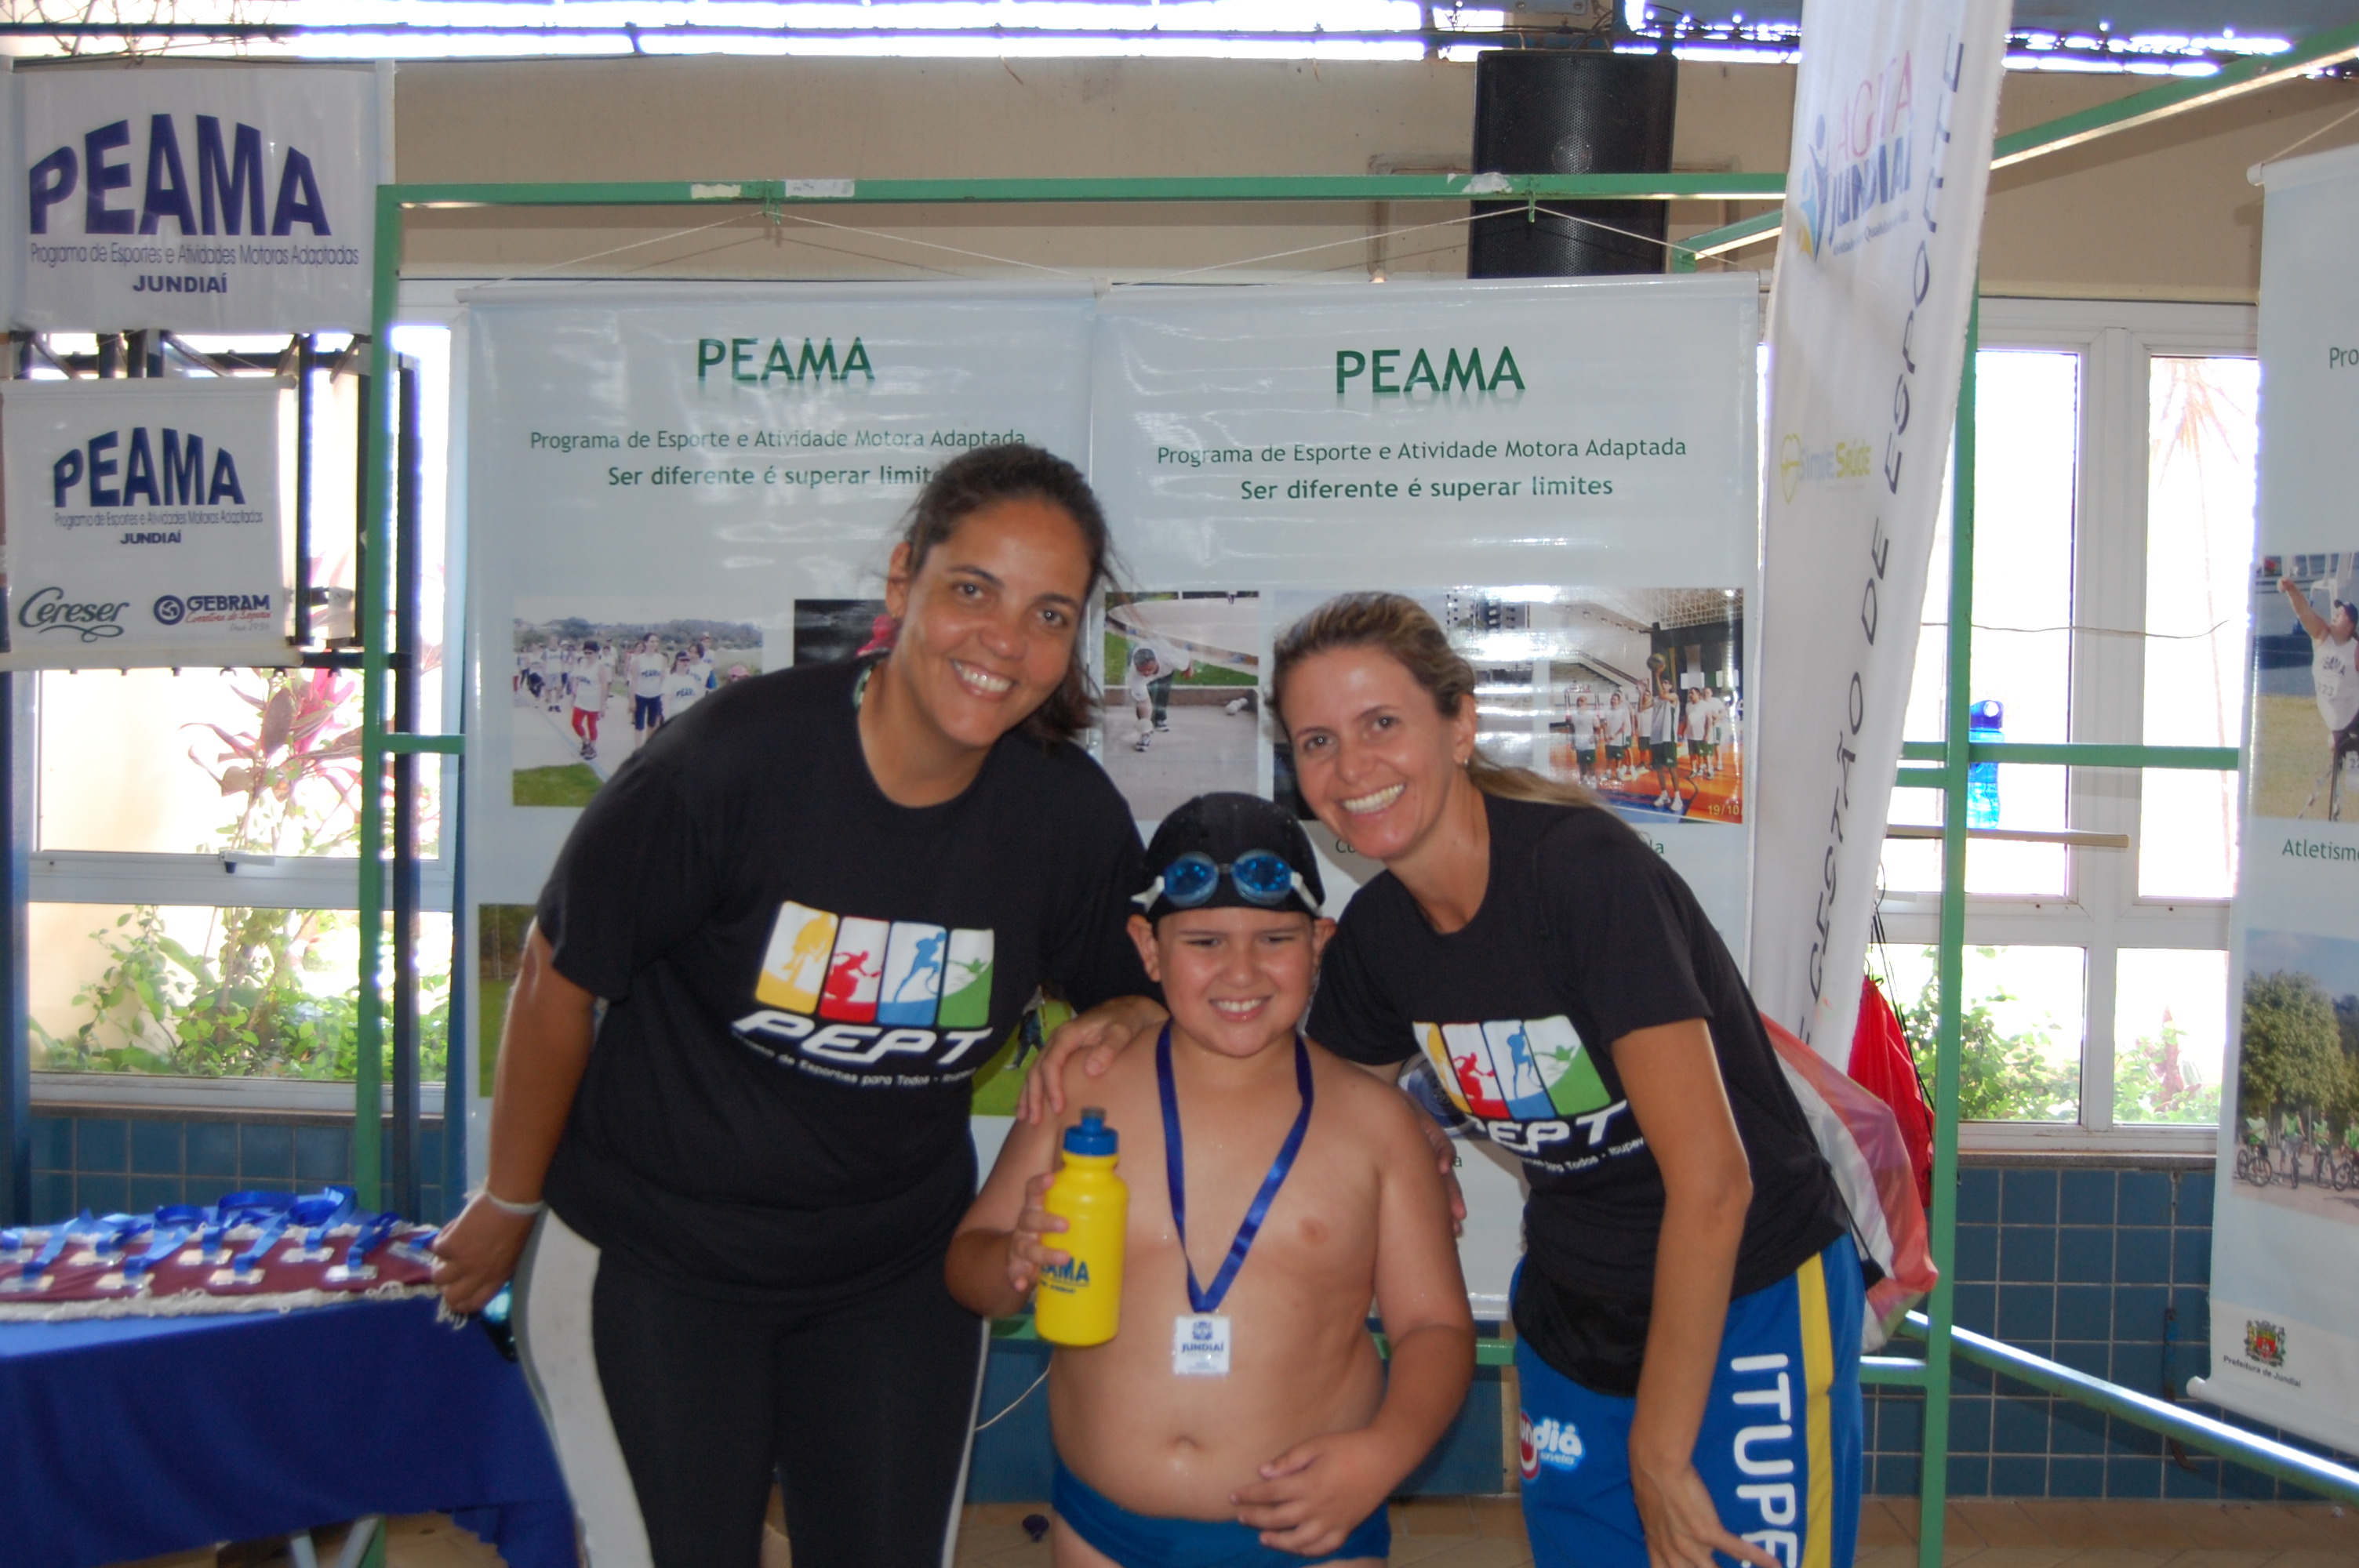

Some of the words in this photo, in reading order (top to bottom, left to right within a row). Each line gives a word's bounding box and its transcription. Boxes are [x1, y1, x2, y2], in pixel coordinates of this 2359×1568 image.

[29, 113, 333, 236] PEAMA
[31, 242, 87, 268] Programa
[90, 242, 107, 263] de
[111, 242, 162, 267] Esportes
[165, 247, 175, 264] e
[177, 244, 235, 265] Atividades
[239, 244, 289, 265] Motoras
[291, 244, 359, 268] Adaptadas
[132, 272, 227, 293] JUNDIAÍ
[697, 336, 876, 383] PEAMA
[1336, 346, 1526, 394] PEAMA
[531, 431, 620, 453] Programa
[627, 431, 650, 448] de
[658, 430, 730, 451] Esporte
[736, 434, 749, 447] e
[754, 430, 848, 448] Atividade
[855, 430, 925, 448] Motora
[931, 429, 1026, 449] Adaptada
[1158, 446, 1253, 467] Programa
[1261, 444, 1286, 461] de
[1294, 444, 1372, 465] Esporte
[1379, 446, 1391, 460] e
[1398, 441, 1498, 459] Atividade
[1505, 440, 1579, 458] Motora
[1585, 437, 1687, 460] Adaptada
[54, 426, 246, 508] PEAMA
[609, 466, 643, 485] Ser
[651, 465, 754, 485] diferente
[763, 465, 777, 485] é
[785, 468, 871, 489] superar
[880, 465, 932, 485] limit
[1241, 481, 1278, 500] Ser
[1287, 479, 1399, 499] diferente
[1408, 477, 1422, 498] é
[1430, 479, 1522, 502] superar
[1532, 476, 1614, 495] limites
[19, 586, 130, 629] Cereser
[186, 593, 271, 612] GEBRAM
[2281, 837, 2359, 862] Atletism
[731, 1009, 994, 1065] PEPT
[1041, 1256, 1091, 1282] AMA
[2223, 1354, 2261, 1374] Prefeitura
[2262, 1367, 2273, 1378] de
